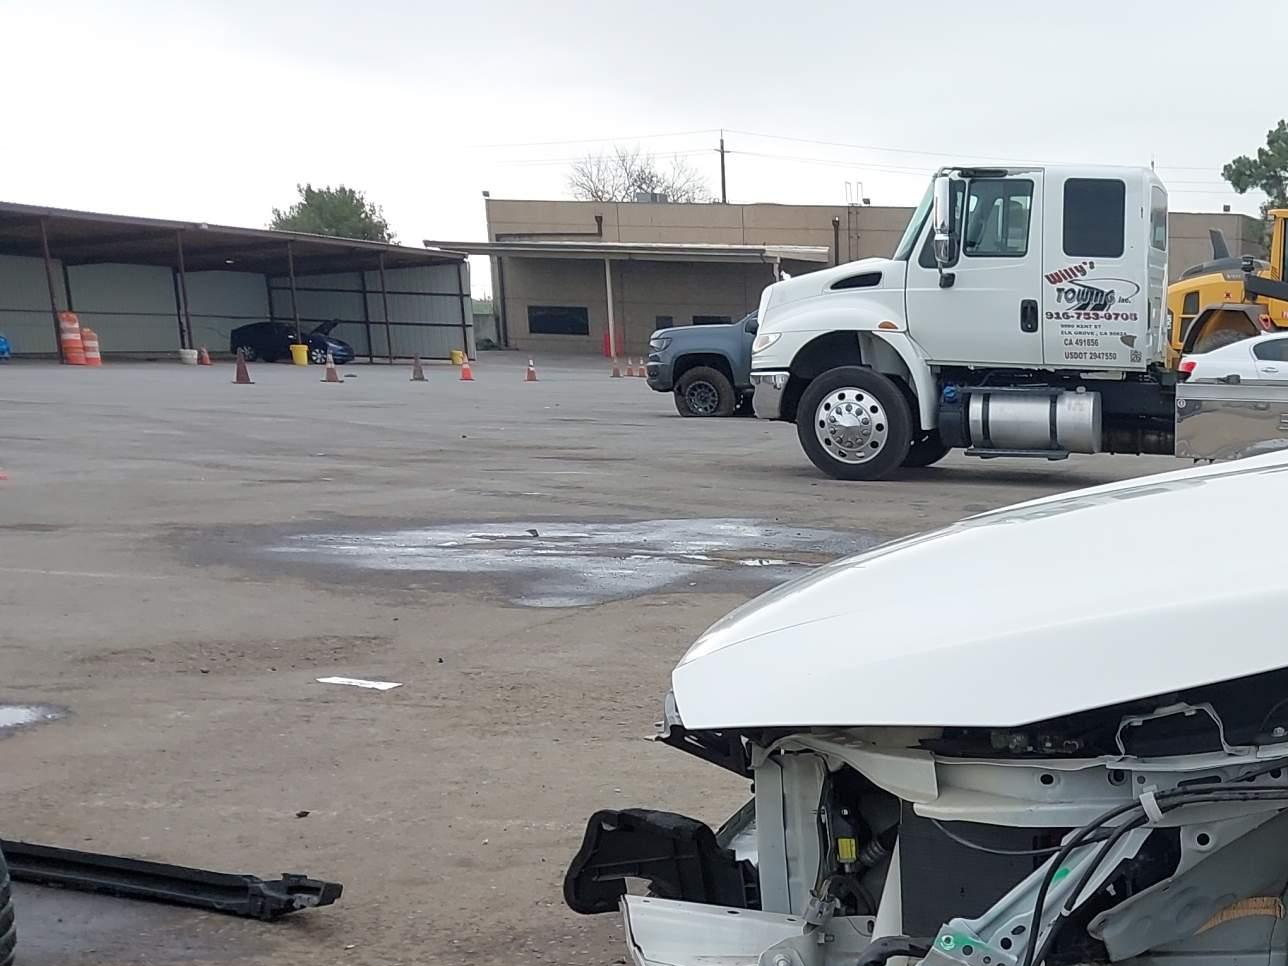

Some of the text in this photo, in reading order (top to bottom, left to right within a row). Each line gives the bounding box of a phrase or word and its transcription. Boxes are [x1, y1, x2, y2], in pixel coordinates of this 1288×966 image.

[1044, 261, 1095, 285] Willy's
[1064, 338, 1073, 346] CA
[1064, 351, 1088, 360] USDOT
